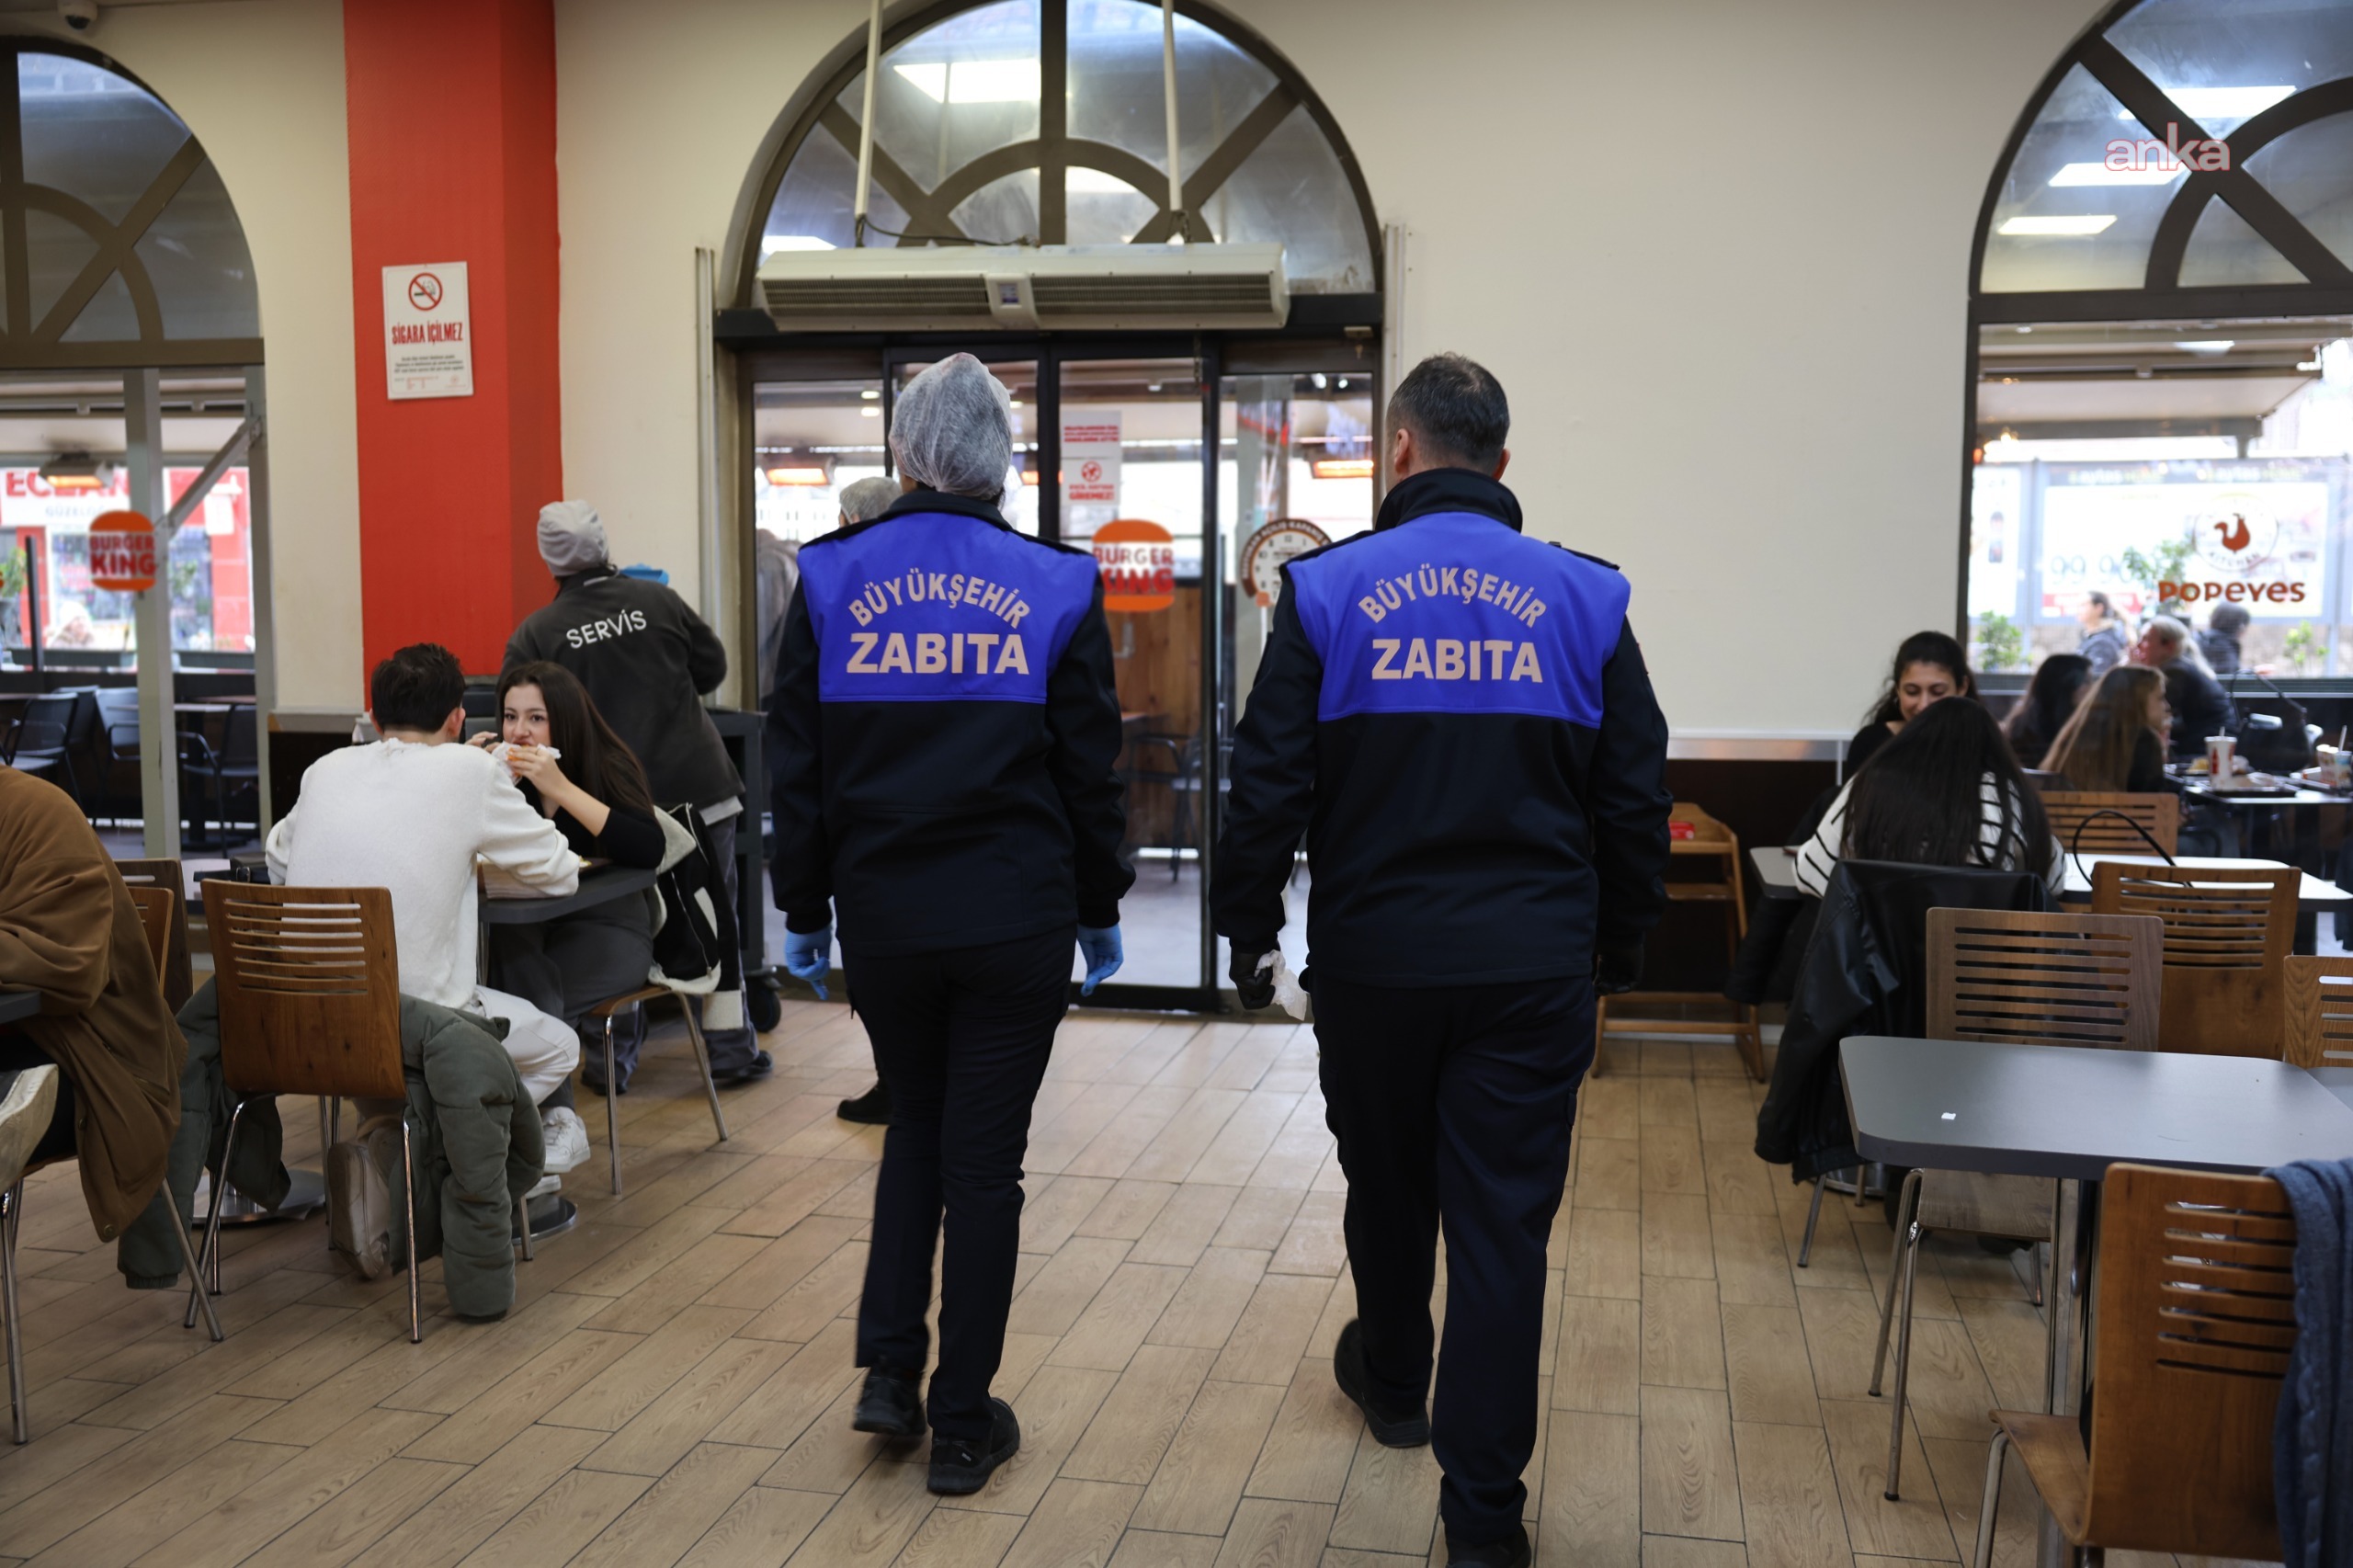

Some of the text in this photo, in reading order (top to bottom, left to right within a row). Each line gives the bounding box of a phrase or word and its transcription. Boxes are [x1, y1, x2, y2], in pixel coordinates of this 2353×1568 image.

[392, 320, 462, 346] SİGARA İÇİLMEZ
[90, 535, 155, 551] BURGER
[1093, 547, 1175, 565] BURGER
[91, 552, 156, 576] KING
[848, 567, 1030, 630] BÜYÜKŞEHİR
[1358, 562, 1547, 629] BÜYÜKŞEHİR
[566, 608, 647, 649] SERVİS
[847, 632, 1029, 675] ZABITA
[1371, 638, 1543, 683] ZABITA
